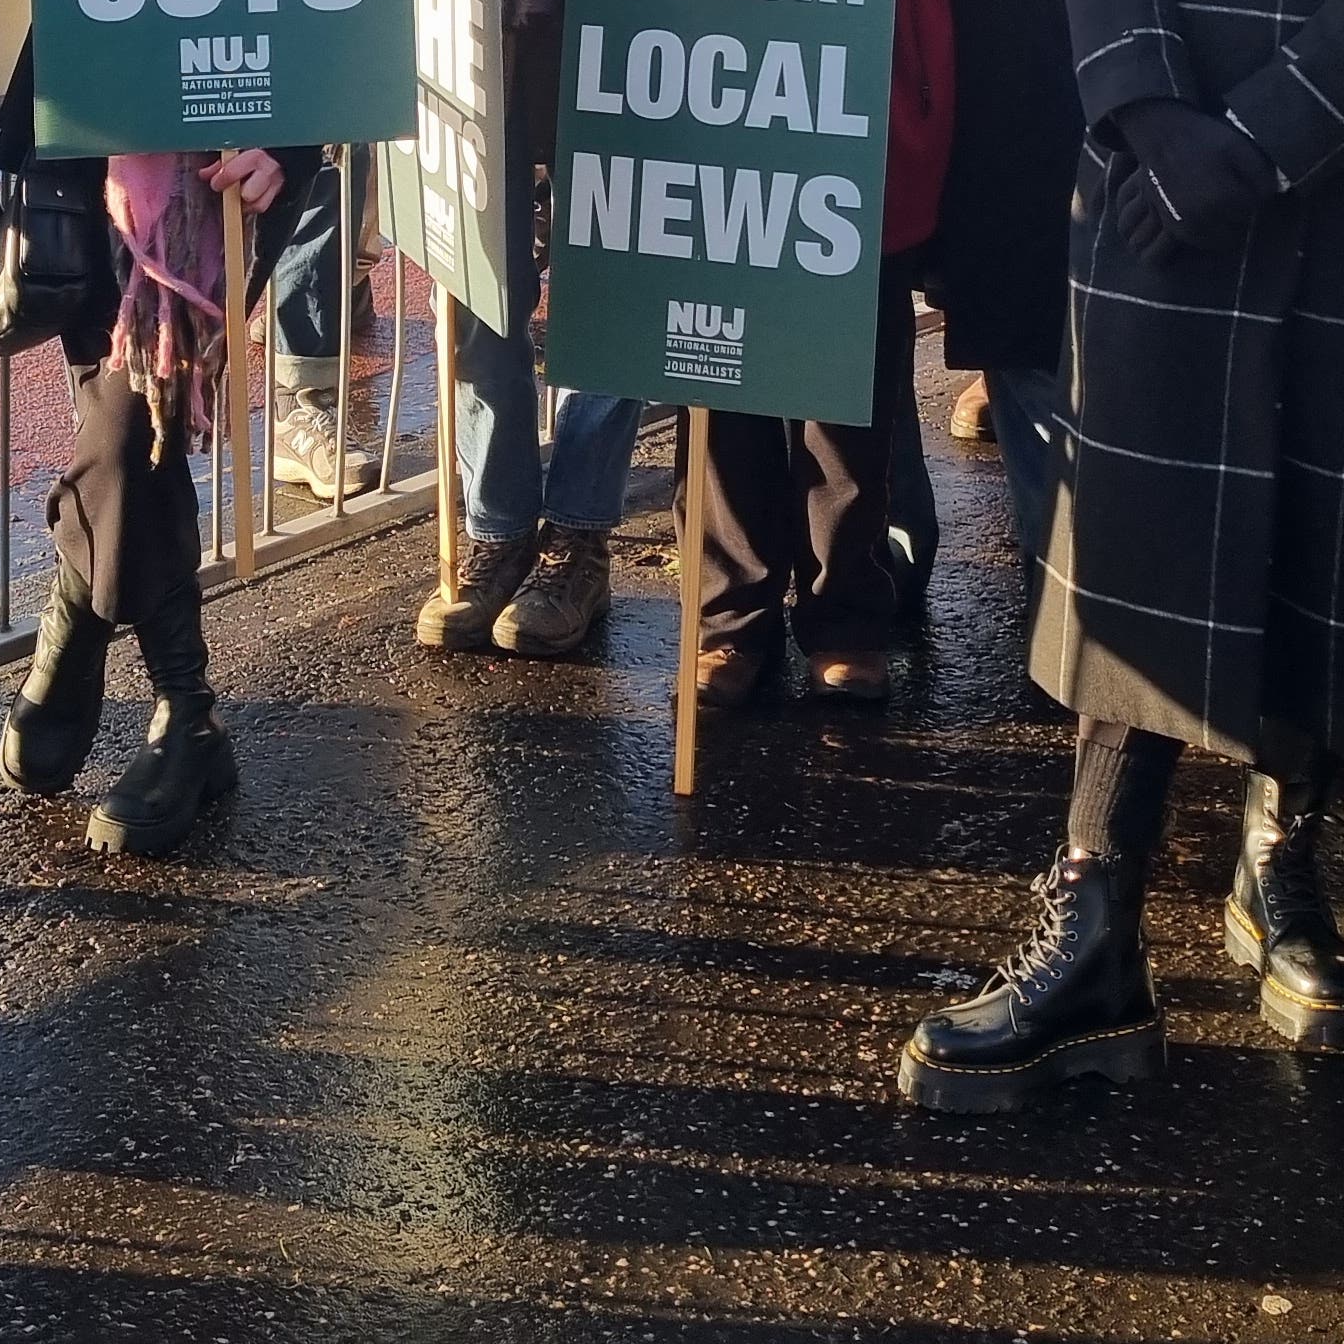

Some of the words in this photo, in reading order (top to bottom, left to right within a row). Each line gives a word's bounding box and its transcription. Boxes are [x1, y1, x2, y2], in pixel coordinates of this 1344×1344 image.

[179, 34, 270, 74] NUJ
[181, 79, 234, 90] NATIONAL
[237, 77, 271, 88] UNION
[220, 91, 233, 100] OF
[576, 24, 870, 139] LOCAL
[182, 100, 272, 116] JOURNALISTS
[395, 83, 488, 213] UTS
[568, 151, 862, 277] NEWS
[666, 299, 746, 341] NUJ
[666, 338, 711, 353] NATIONAL
[713, 344, 743, 356] UNION
[664, 359, 742, 380] JOURNALISTS
